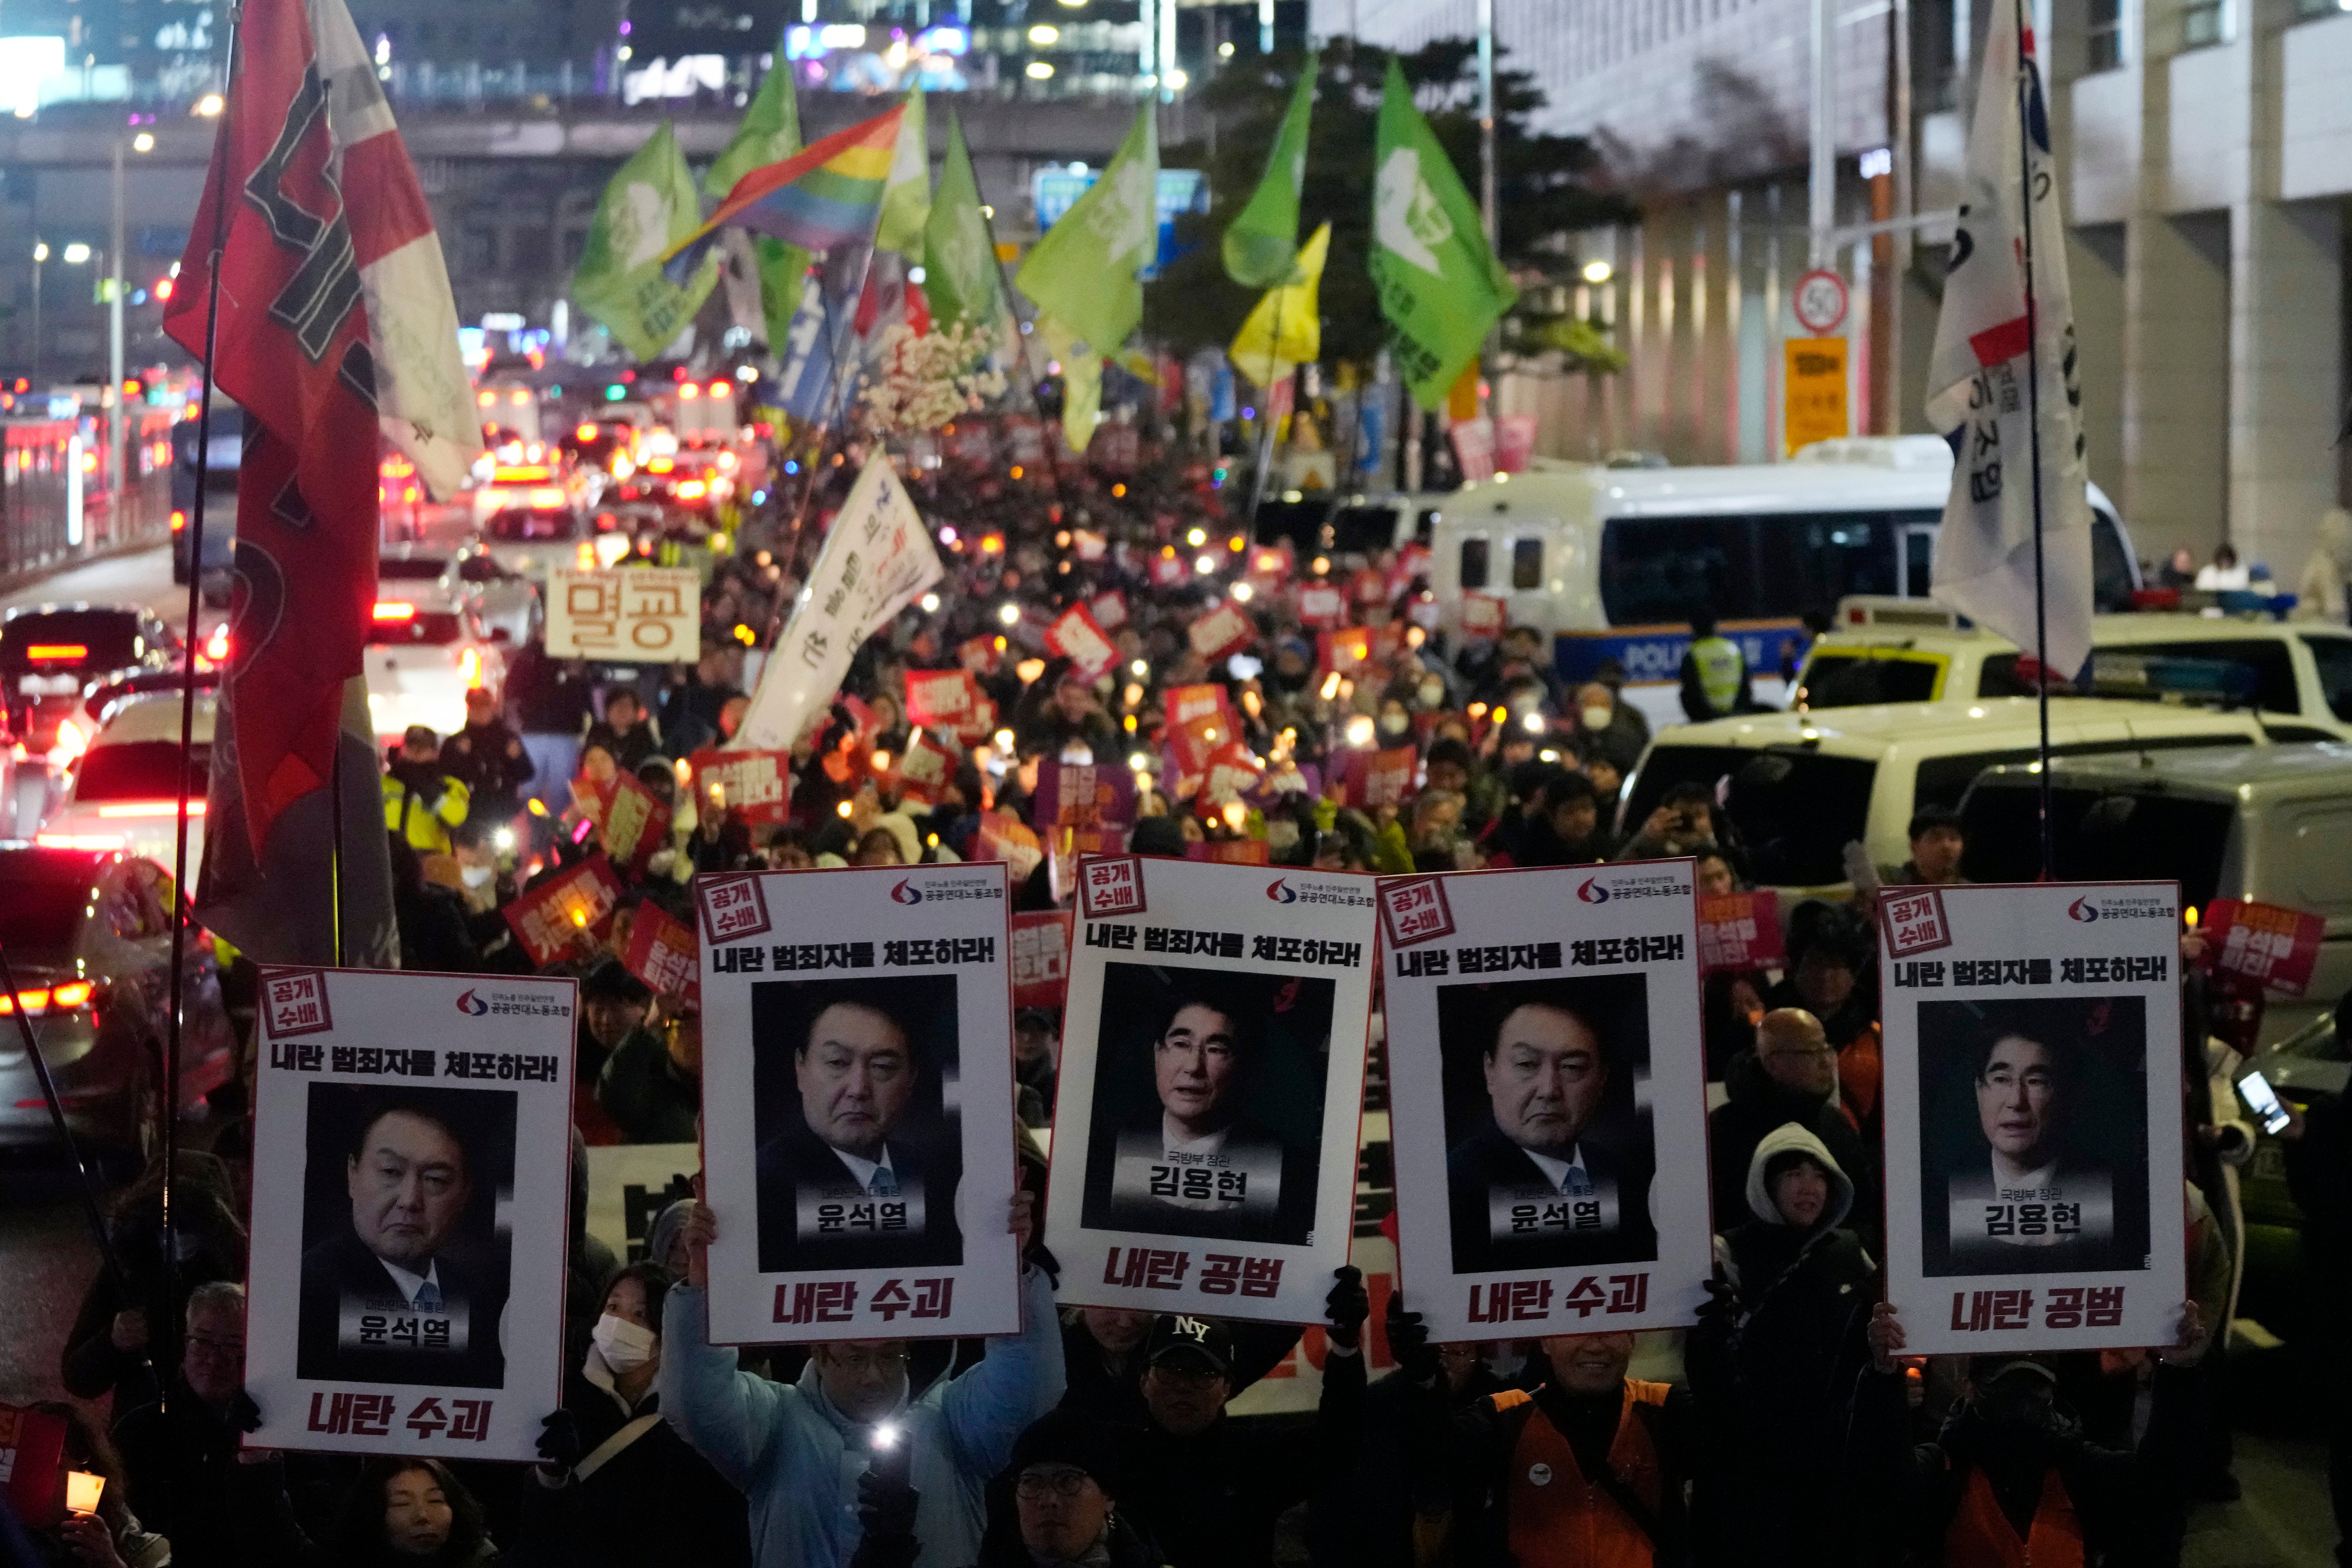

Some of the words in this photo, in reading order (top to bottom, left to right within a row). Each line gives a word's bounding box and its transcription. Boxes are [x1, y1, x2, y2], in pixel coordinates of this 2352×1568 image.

[1092, 864, 1130, 885] 공개
[711, 881, 751, 909] 공개
[926, 888, 1002, 901] 공공연대노동조합
[1094, 886, 1133, 908] 수배
[1299, 892, 1375, 907] 공공연대노동조합
[1392, 886, 1434, 914] 공개
[1612, 885, 1691, 899] 공공연대노동조합
[716, 906, 757, 932] 수배
[1892, 897, 1932, 923] 공개
[2101, 907, 2175, 919] 공공연대노동조합
[1399, 912, 1440, 937] 수배
[1898, 921, 1938, 946] 수배
[713, 946, 763, 973] 내란
[772, 942, 874, 971] 범죄자를
[883, 937, 994, 967] 체포하라!
[1085, 923, 1137, 951] 내란
[1144, 927, 1244, 959] 범죄자를
[1252, 935, 1360, 967] 체포하라!
[1396, 949, 1449, 978] 내란
[1458, 943, 1561, 974] 범죄자를
[1570, 934, 1683, 967] 체포하라!
[1894, 961, 1945, 988] 내란
[1952, 959, 2053, 986] 범죄자를
[2060, 956, 2167, 984] 체포하라!
[272, 981, 313, 1003] 공개
[277, 1003, 318, 1027] 수배
[491, 1003, 570, 1017] 공공연대노동조합
[271, 1044, 322, 1072] 내란
[331, 1048, 435, 1077] 범죄자를
[444, 1052, 558, 1082] 체포하라!
[1168, 1151, 1203, 1165] 국방부
[1207, 1155, 1231, 1168] 장관
[1150, 1165, 1247, 1202] 김용현
[2001, 1189, 2036, 1201] 국방부
[2039, 1187, 2062, 1200] 장관
[818, 1202, 907, 1233] 윤석열
[1511, 1201, 1601, 1233] 윤석열
[1986, 1203, 2081, 1236] 김용현
[1104, 1247, 1190, 1289] 내란
[1199, 1254, 1284, 1298] 공범
[772, 1280, 857, 1324] 내란
[870, 1277, 954, 1321] 수괴
[1468, 1279, 1554, 1323] 내란
[1566, 1273, 1648, 1317] 수괴
[1950, 1289, 2035, 1332] 내란
[2045, 1286, 2125, 1328] 공범
[360, 1316, 450, 1347] 윤석열
[1172, 1315, 1211, 1343] NY
[307, 1392, 395, 1435] 내란
[406, 1397, 493, 1443] 수괴
